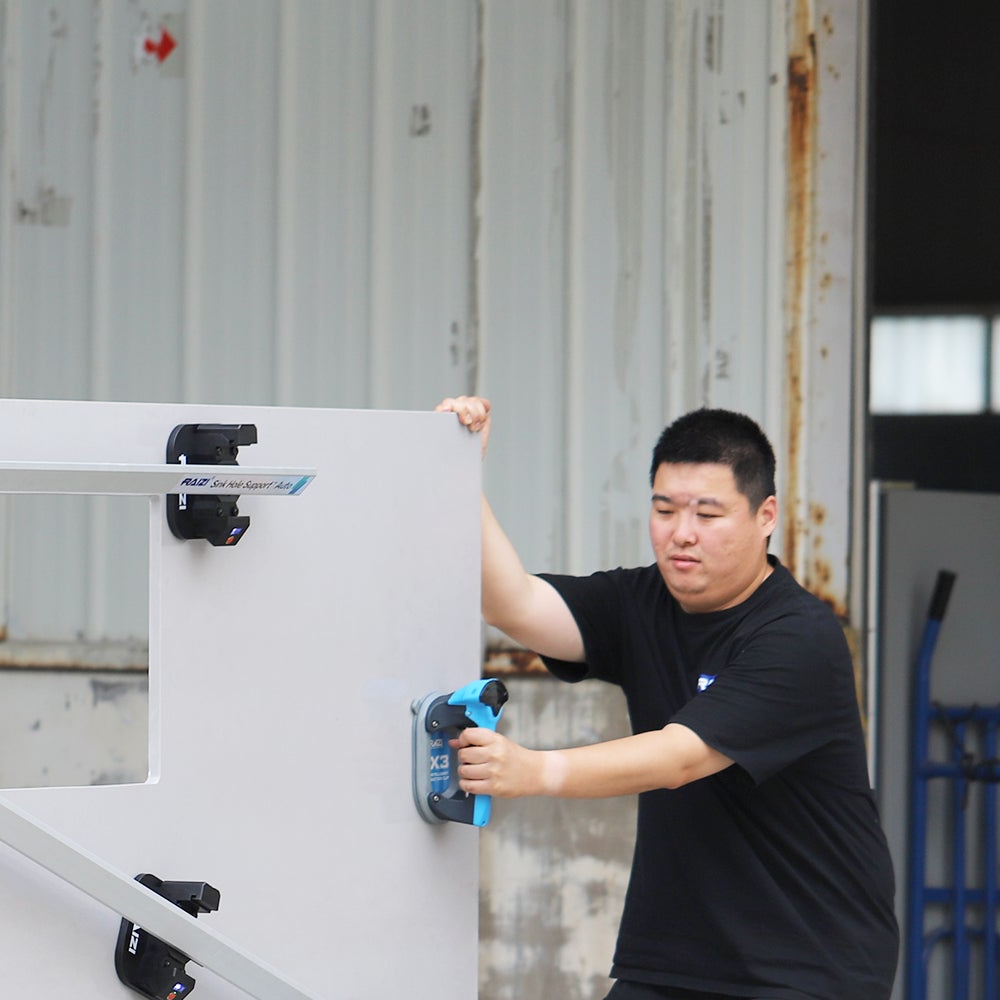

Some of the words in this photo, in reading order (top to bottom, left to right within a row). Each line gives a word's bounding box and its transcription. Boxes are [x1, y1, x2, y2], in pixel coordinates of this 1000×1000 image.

[180, 478, 211, 487] RAIZI
[210, 480, 227, 489] Sink
[227, 480, 243, 489] Hole
[274, 481, 293, 490] Auto
[430, 754, 449, 770] X3
